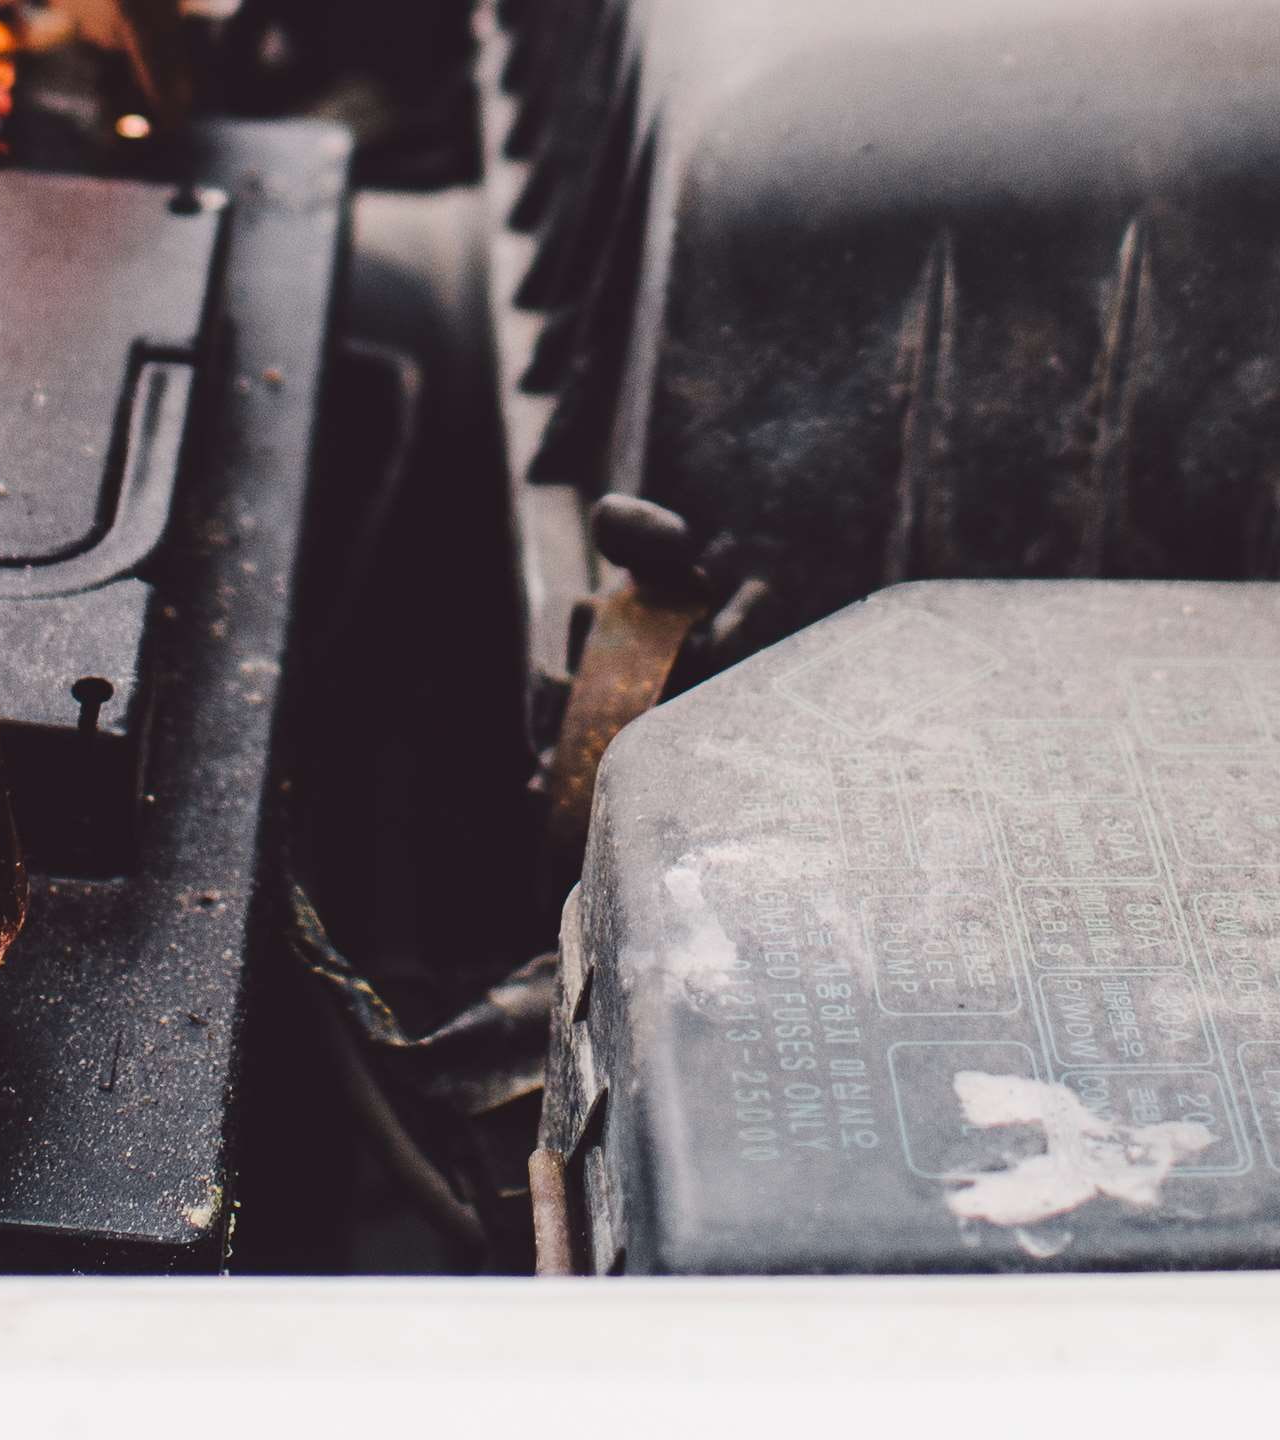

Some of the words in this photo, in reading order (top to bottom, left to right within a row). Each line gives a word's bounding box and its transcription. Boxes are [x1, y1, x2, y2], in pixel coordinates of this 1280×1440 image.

[879, 922, 918, 994] PUMP
[918, 924, 956, 990] FUEL
[770, 993, 815, 1070] FUSES
[1053, 979, 1099, 1059] P/WDW
[782, 1082, 828, 1151] ONLY
